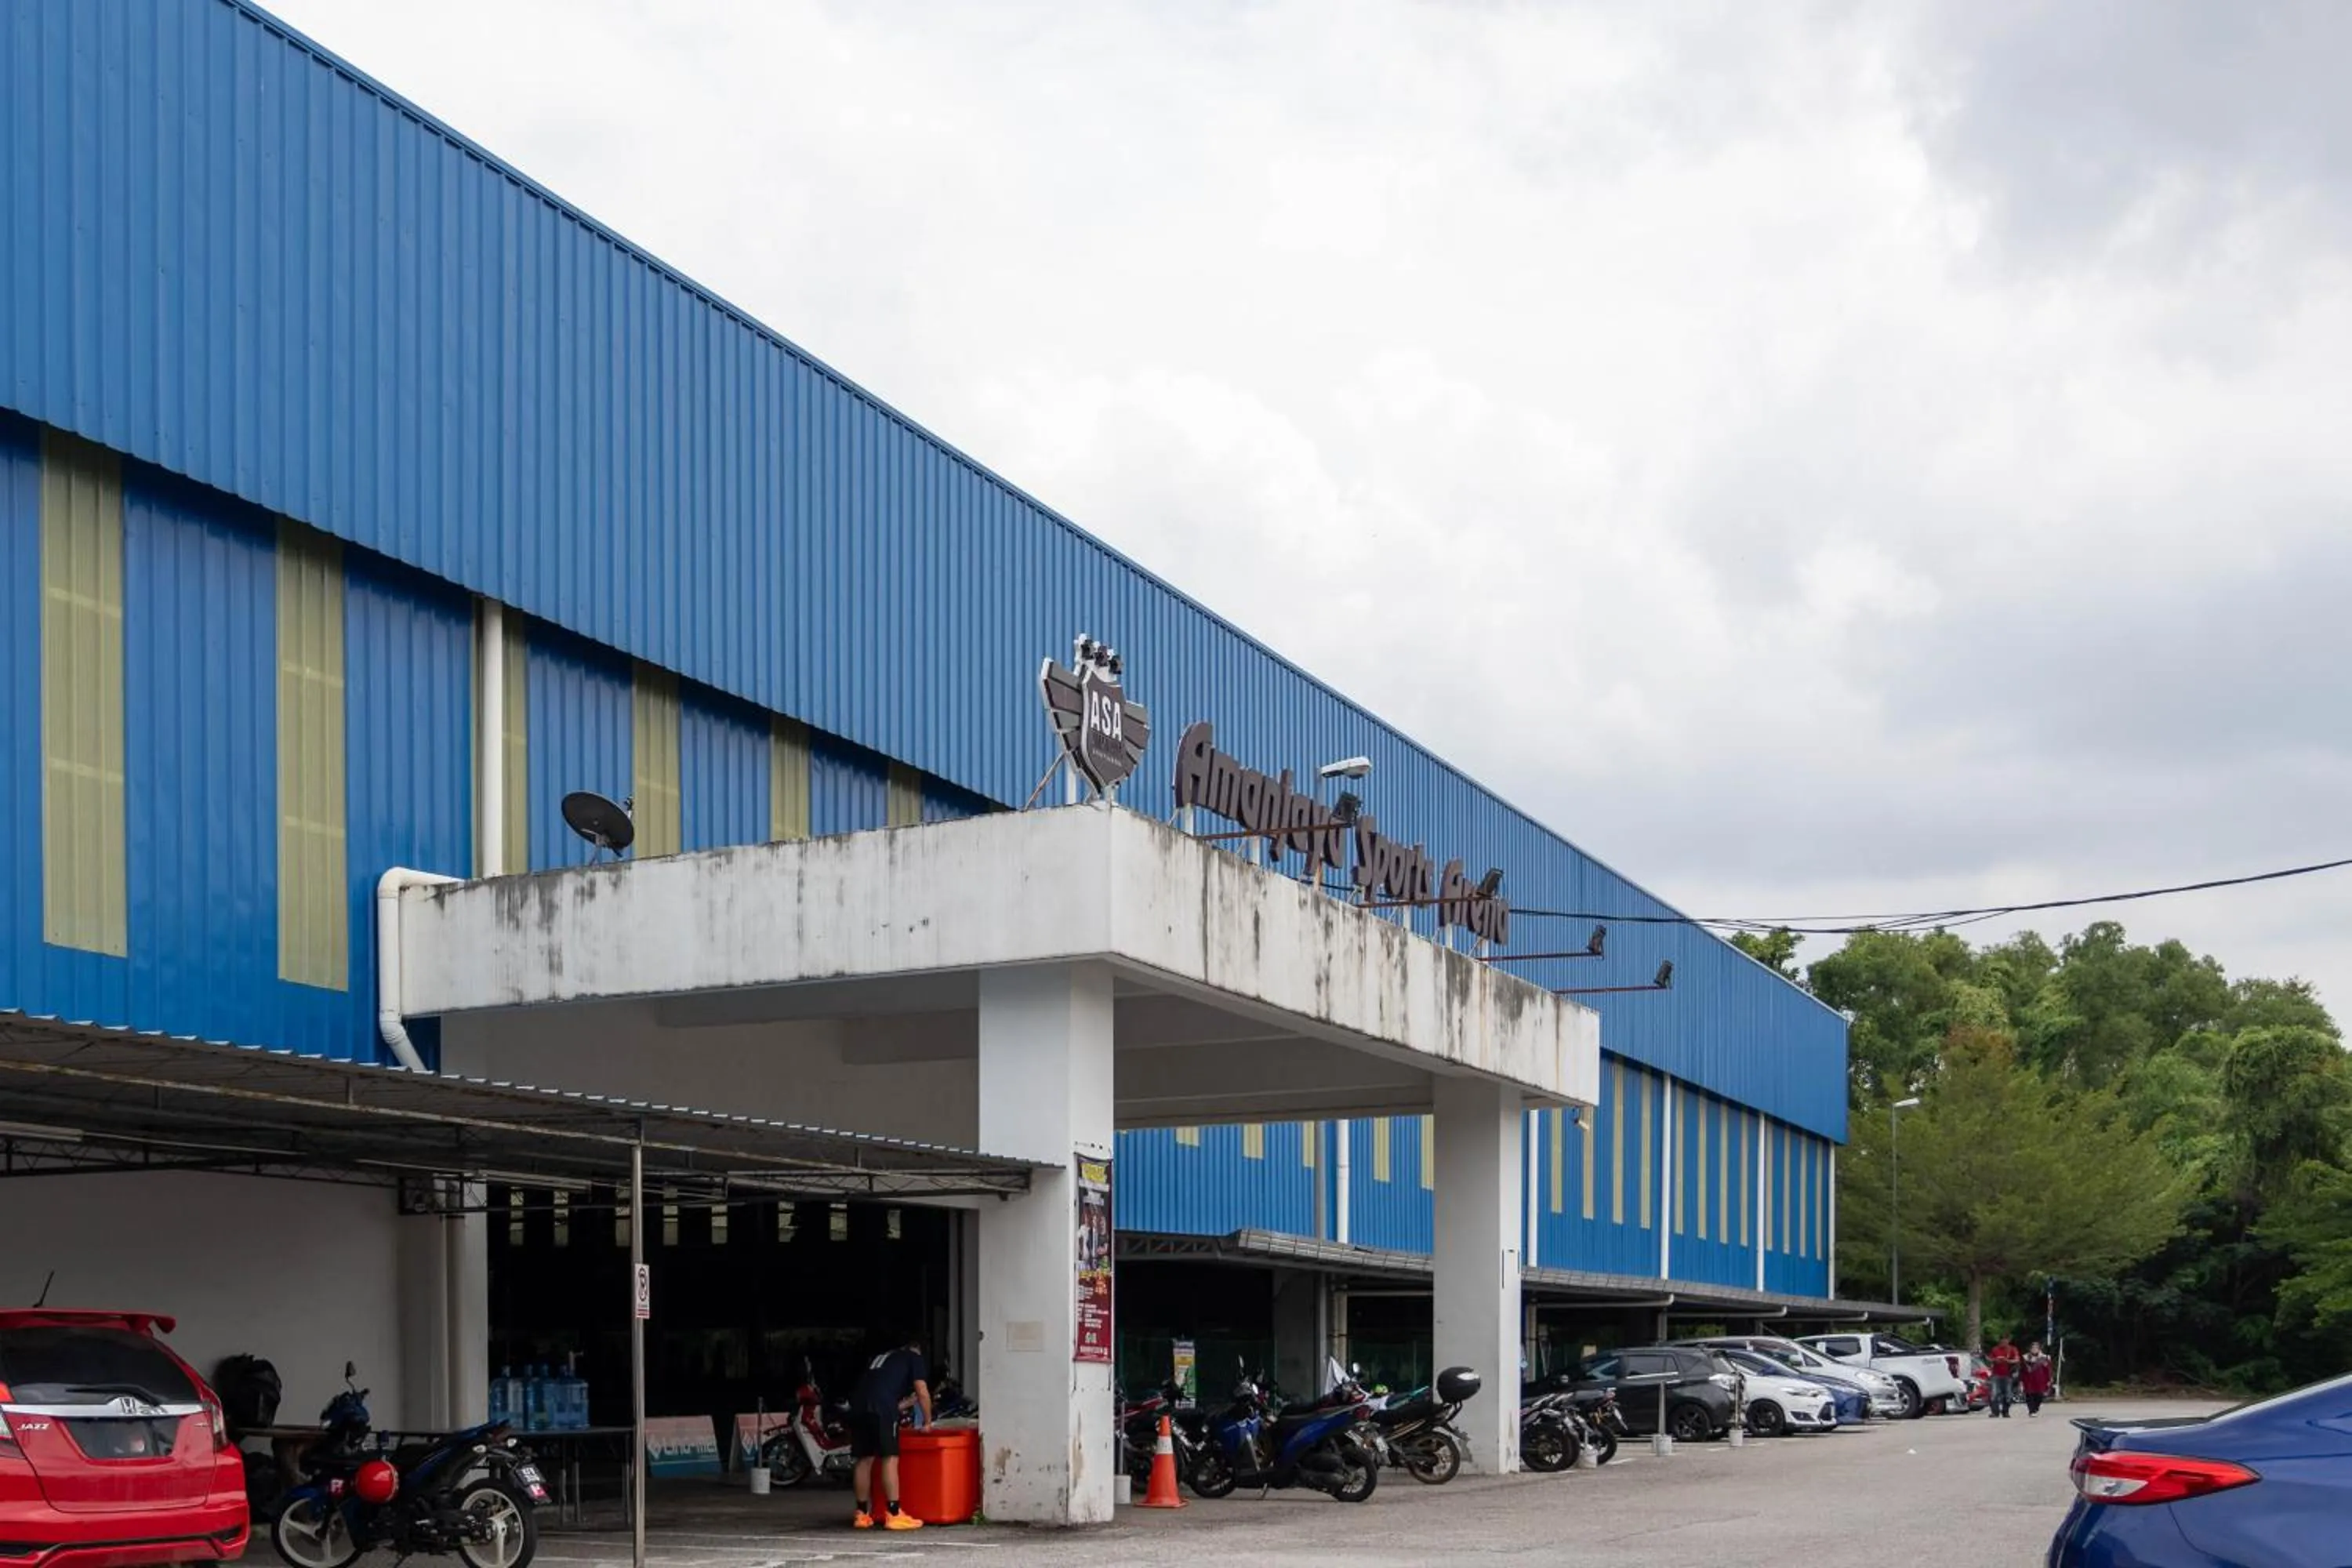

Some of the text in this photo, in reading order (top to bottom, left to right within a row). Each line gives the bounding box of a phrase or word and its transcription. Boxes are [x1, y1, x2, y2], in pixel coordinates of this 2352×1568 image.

[1091, 690, 1122, 741] ASA
[1352, 815, 1434, 907] Sports
[1439, 856, 1509, 946] Arena
